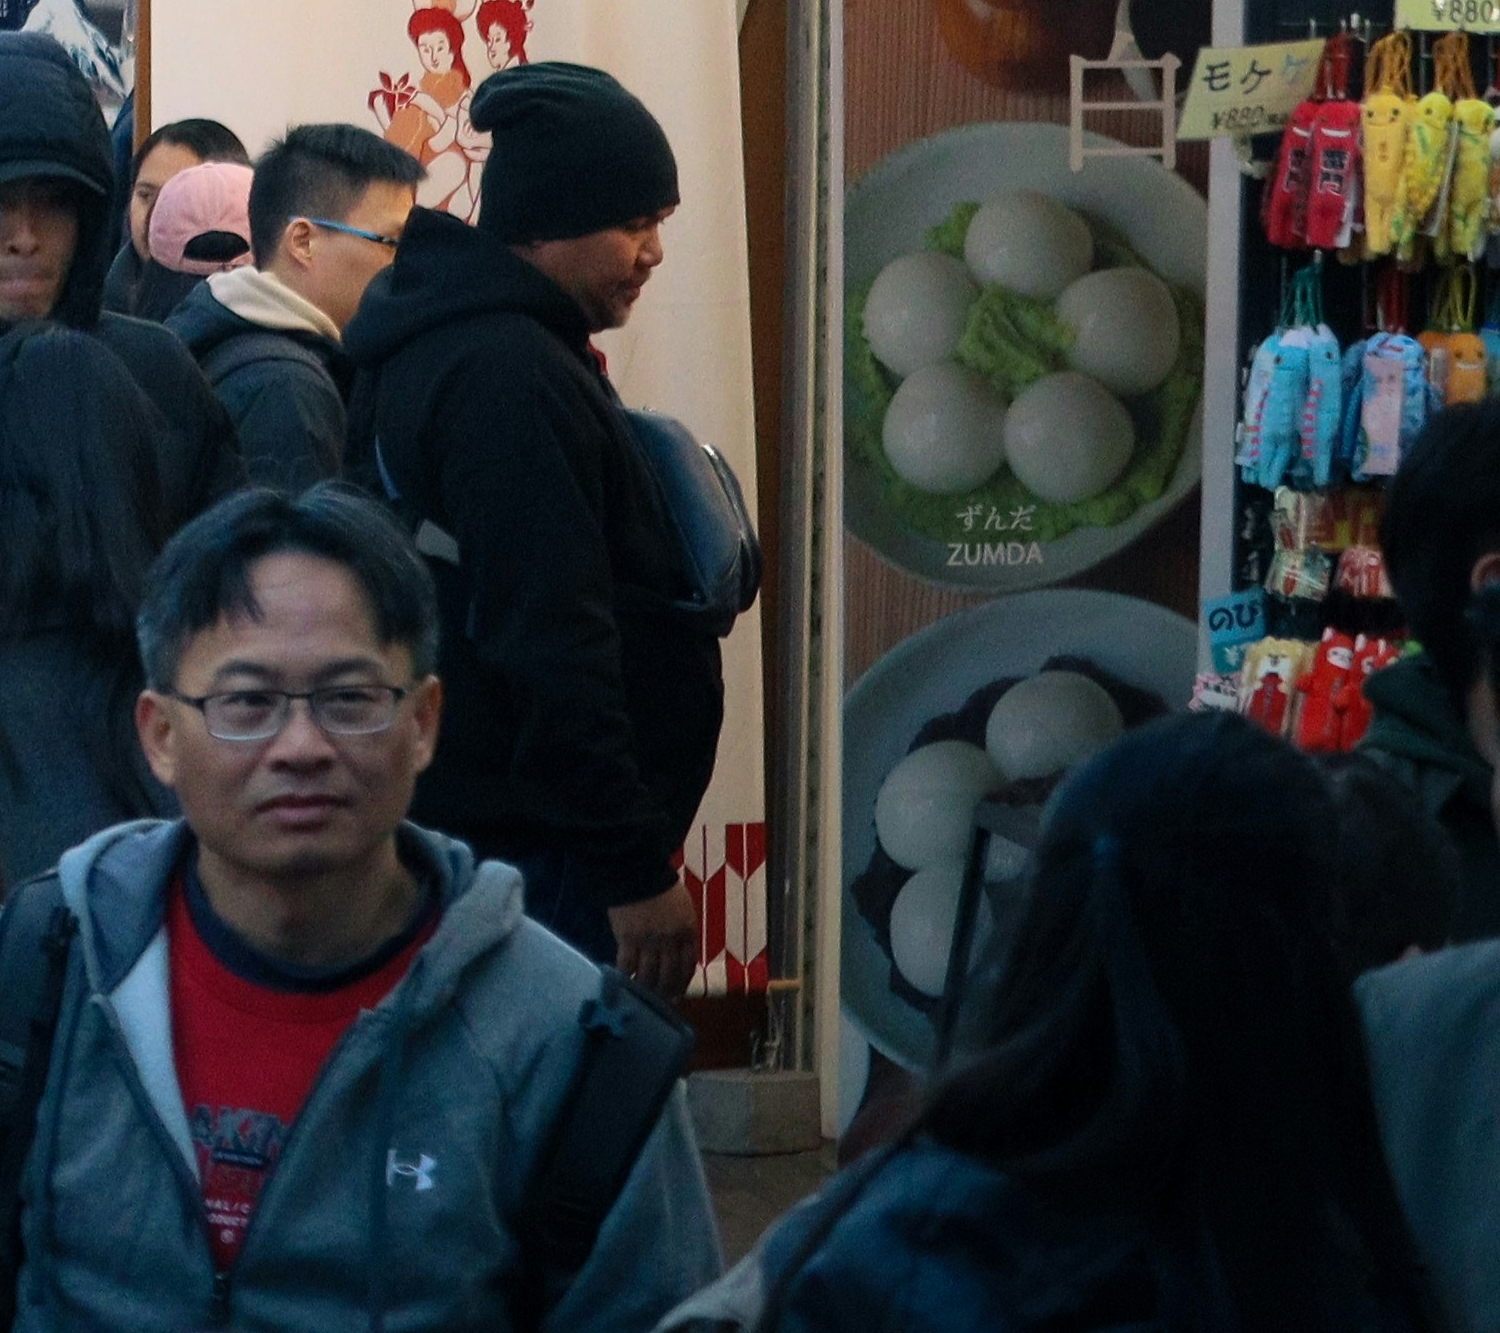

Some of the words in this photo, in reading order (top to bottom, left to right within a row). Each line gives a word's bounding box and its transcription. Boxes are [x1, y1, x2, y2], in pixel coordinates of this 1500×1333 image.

[955, 504, 1038, 533] ずんだ
[945, 543, 1044, 568] ZUMDA
